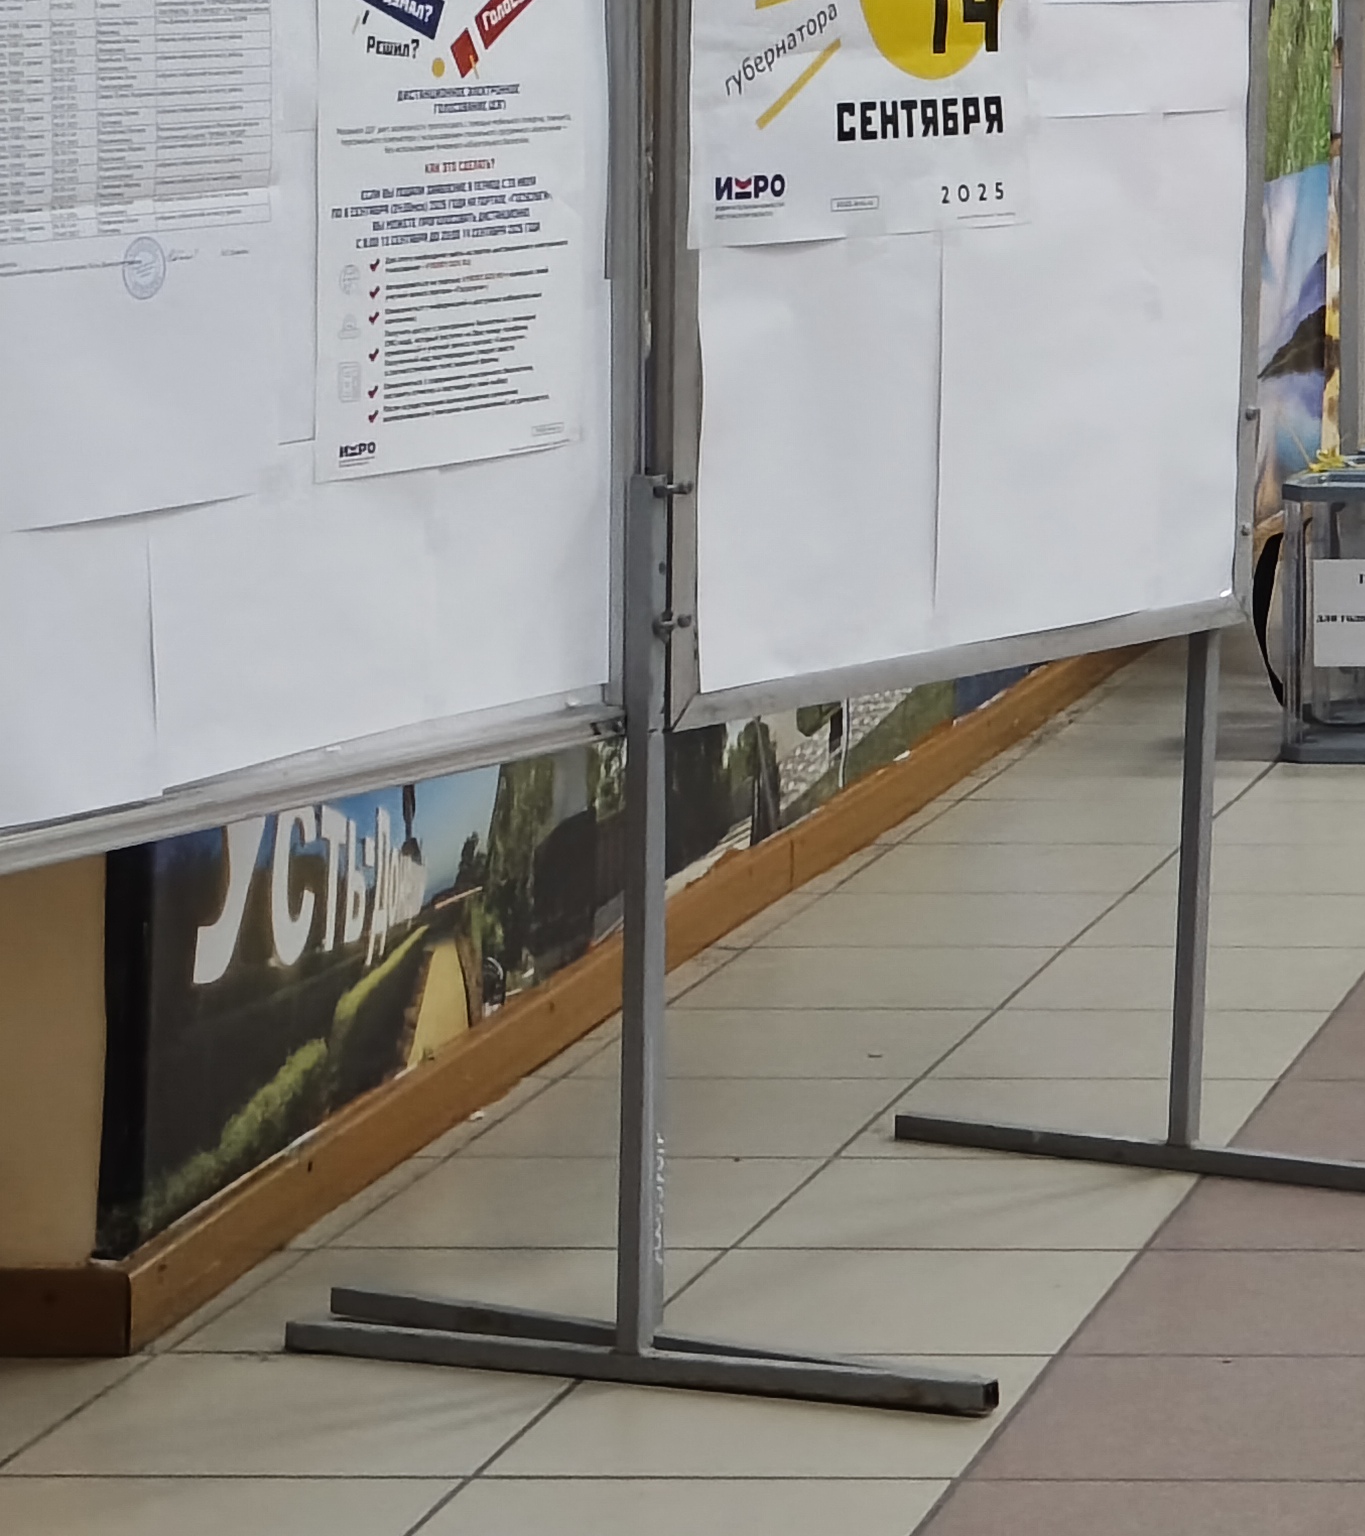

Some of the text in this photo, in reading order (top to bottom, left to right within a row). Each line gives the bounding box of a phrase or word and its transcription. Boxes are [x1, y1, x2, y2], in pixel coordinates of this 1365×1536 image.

[724, 2, 839, 97] губернатора
[836, 95, 1004, 143] СЕНТЯБРЯ
[940, 182, 1005, 205] 2025
